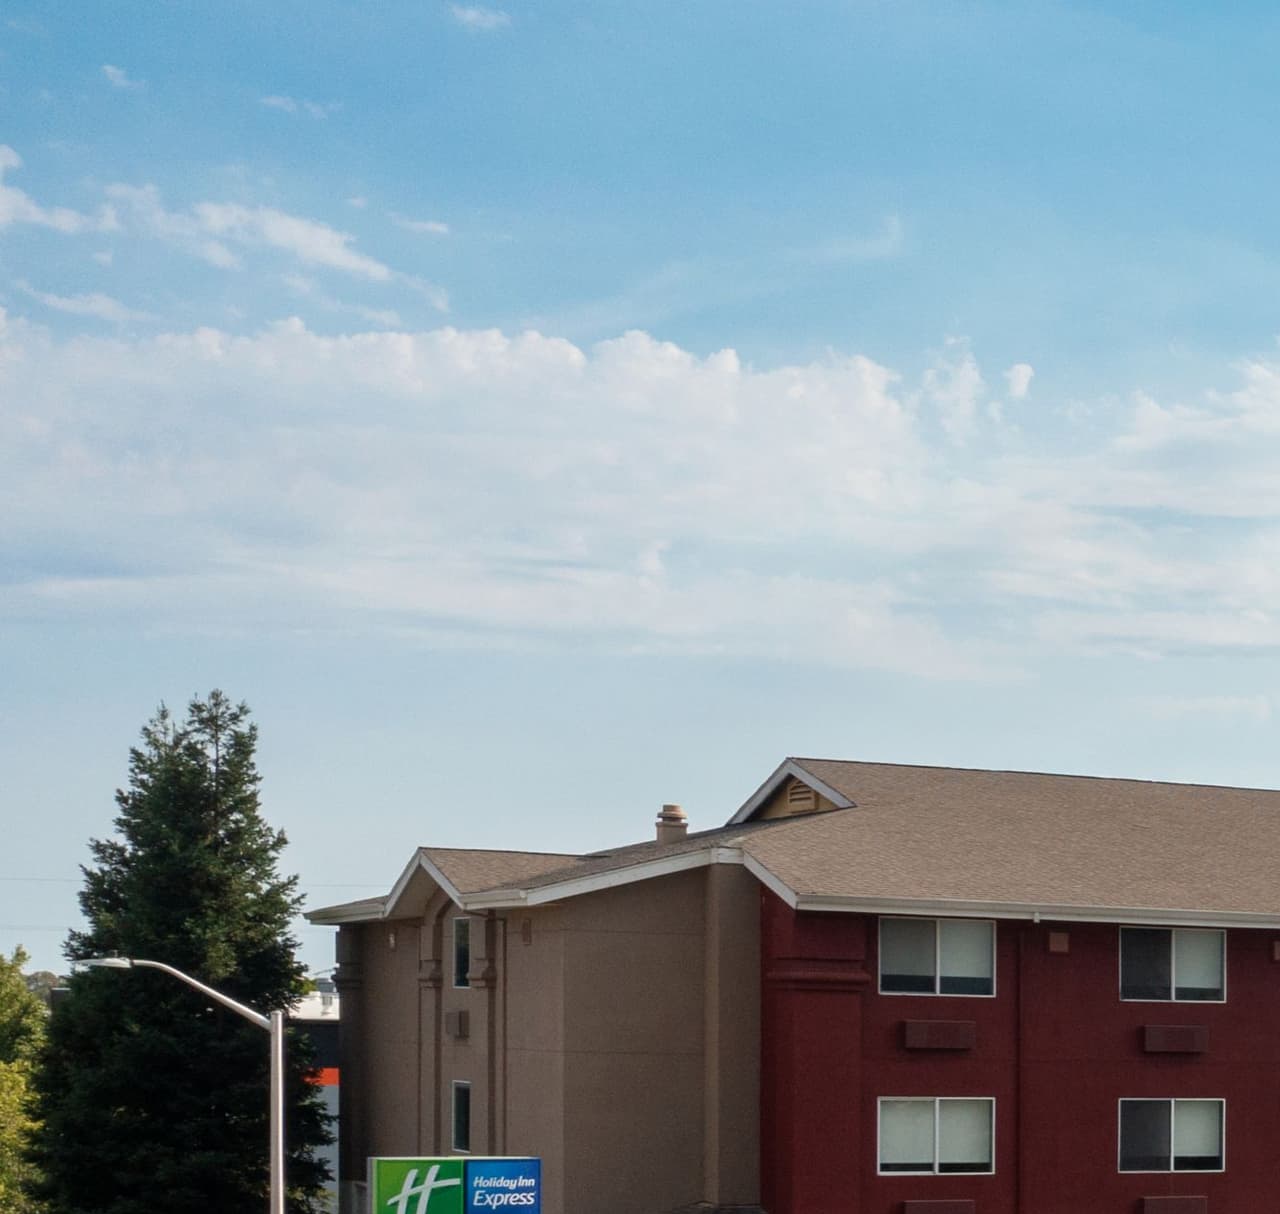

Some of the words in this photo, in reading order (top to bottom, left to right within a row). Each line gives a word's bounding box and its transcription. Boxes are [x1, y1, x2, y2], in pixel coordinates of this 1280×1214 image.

[473, 1176, 516, 1189] Holiday
[517, 1176, 535, 1187] Inn
[473, 1190, 536, 1209] Express
